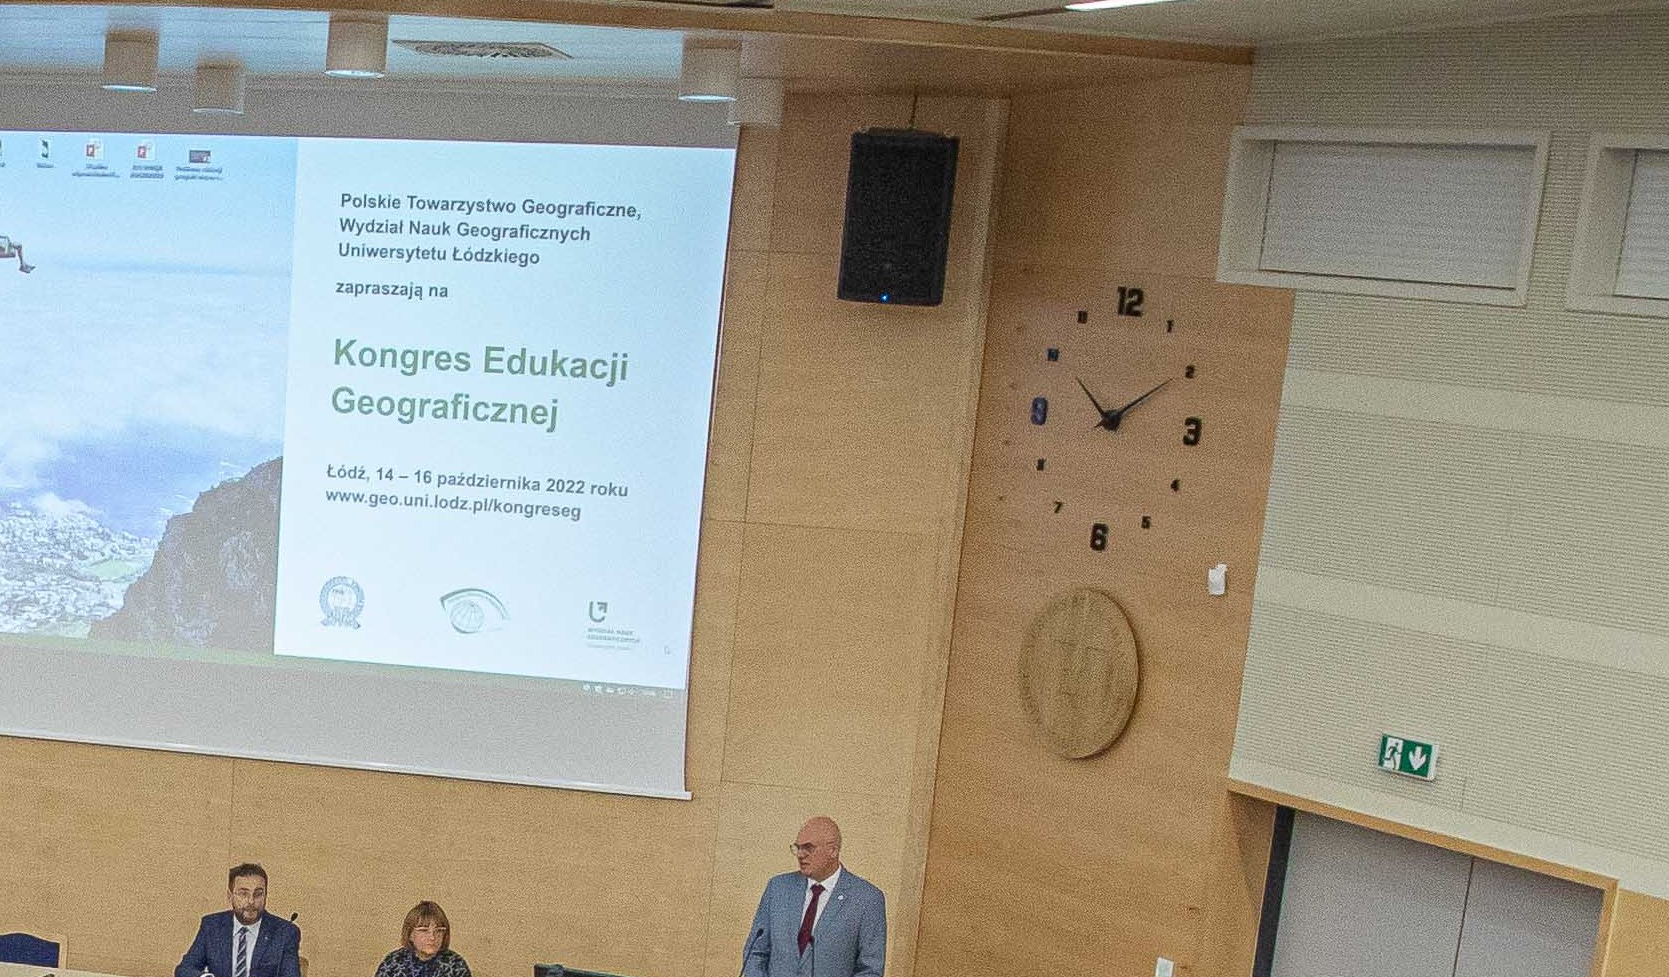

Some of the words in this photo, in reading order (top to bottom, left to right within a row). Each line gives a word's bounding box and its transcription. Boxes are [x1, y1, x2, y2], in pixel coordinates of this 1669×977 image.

[340, 193, 401, 210] Polskie
[407, 194, 516, 215] Towarzystwo
[522, 198, 642, 220] Geograficzne,
[339, 218, 403, 236] Wydział
[408, 220, 451, 236] Nauk
[457, 222, 591, 243] Geograficznych
[338, 242, 447, 262] Uniwersytetu
[452, 245, 540, 267] Łódzkiego
[335, 281, 423, 300] zapraszają
[428, 284, 449, 298] na
[1116, 286, 1145, 318] 12
[333, 338, 471, 376] Kongres
[484, 345, 629, 388] Edukacji
[331, 386, 559, 433] Geograficznej
[1182, 416, 1203, 447] 3
[326, 464, 370, 484] Łódź,
[376, 467, 394, 482] 14
[414, 470, 432, 485] 16
[437, 471, 541, 492] października
[546, 478, 586, 496] 2022
[590, 481, 629, 498] roku
[325, 488, 582, 521] www.geo.uni.lodz.pl/kongreseg
[1089, 522, 1109, 552] 6
